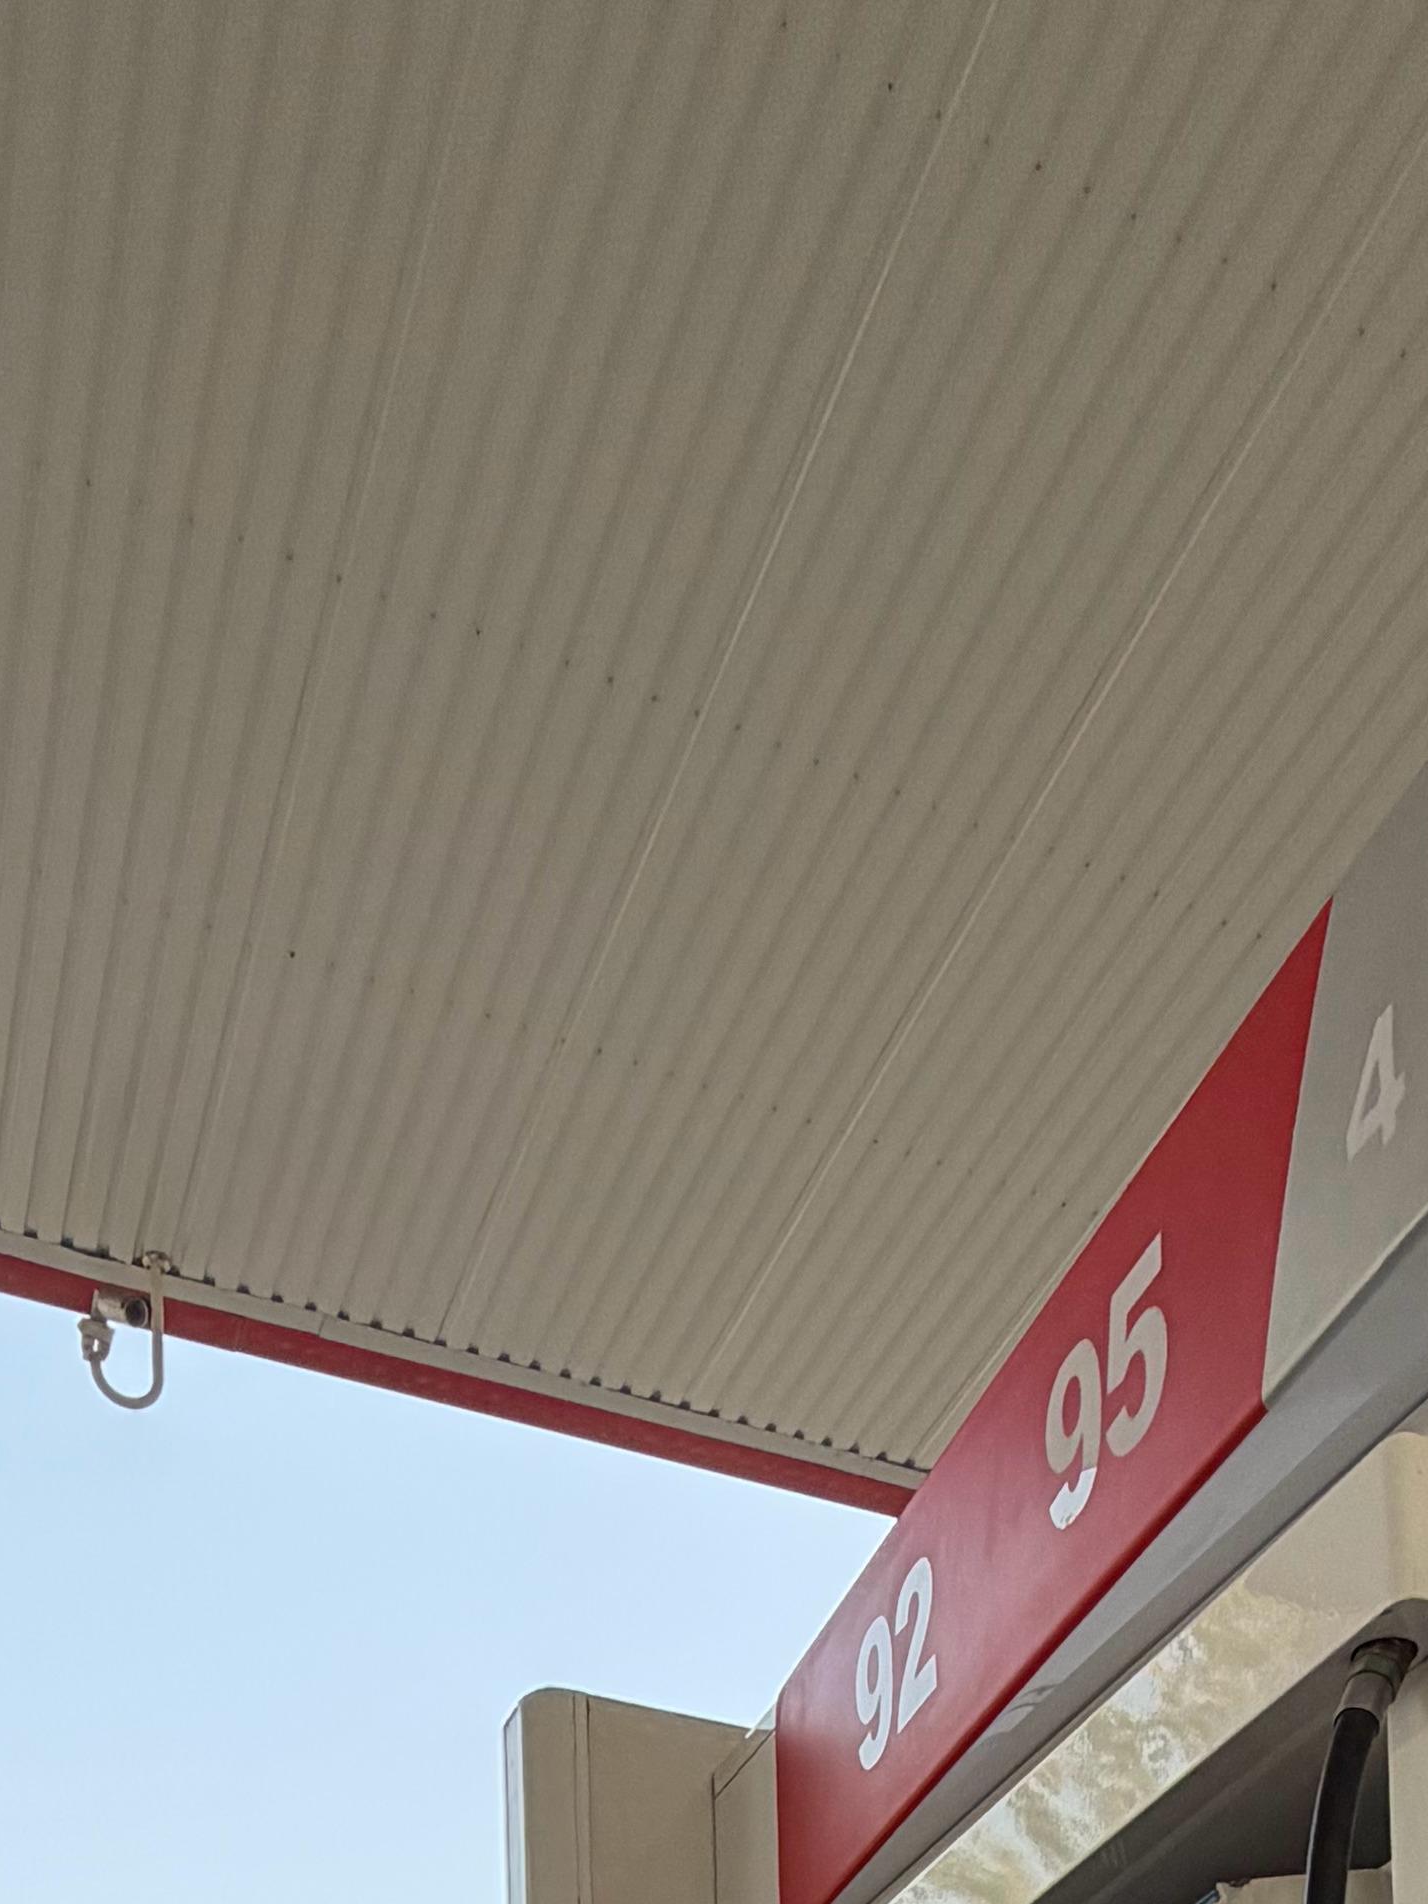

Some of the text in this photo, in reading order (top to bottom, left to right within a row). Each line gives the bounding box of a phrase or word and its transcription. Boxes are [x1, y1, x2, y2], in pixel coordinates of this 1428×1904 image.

[1346, 1003, 1406, 1162] 4
[1045, 1231, 1168, 1530] 95
[855, 1556, 938, 1771] 92
